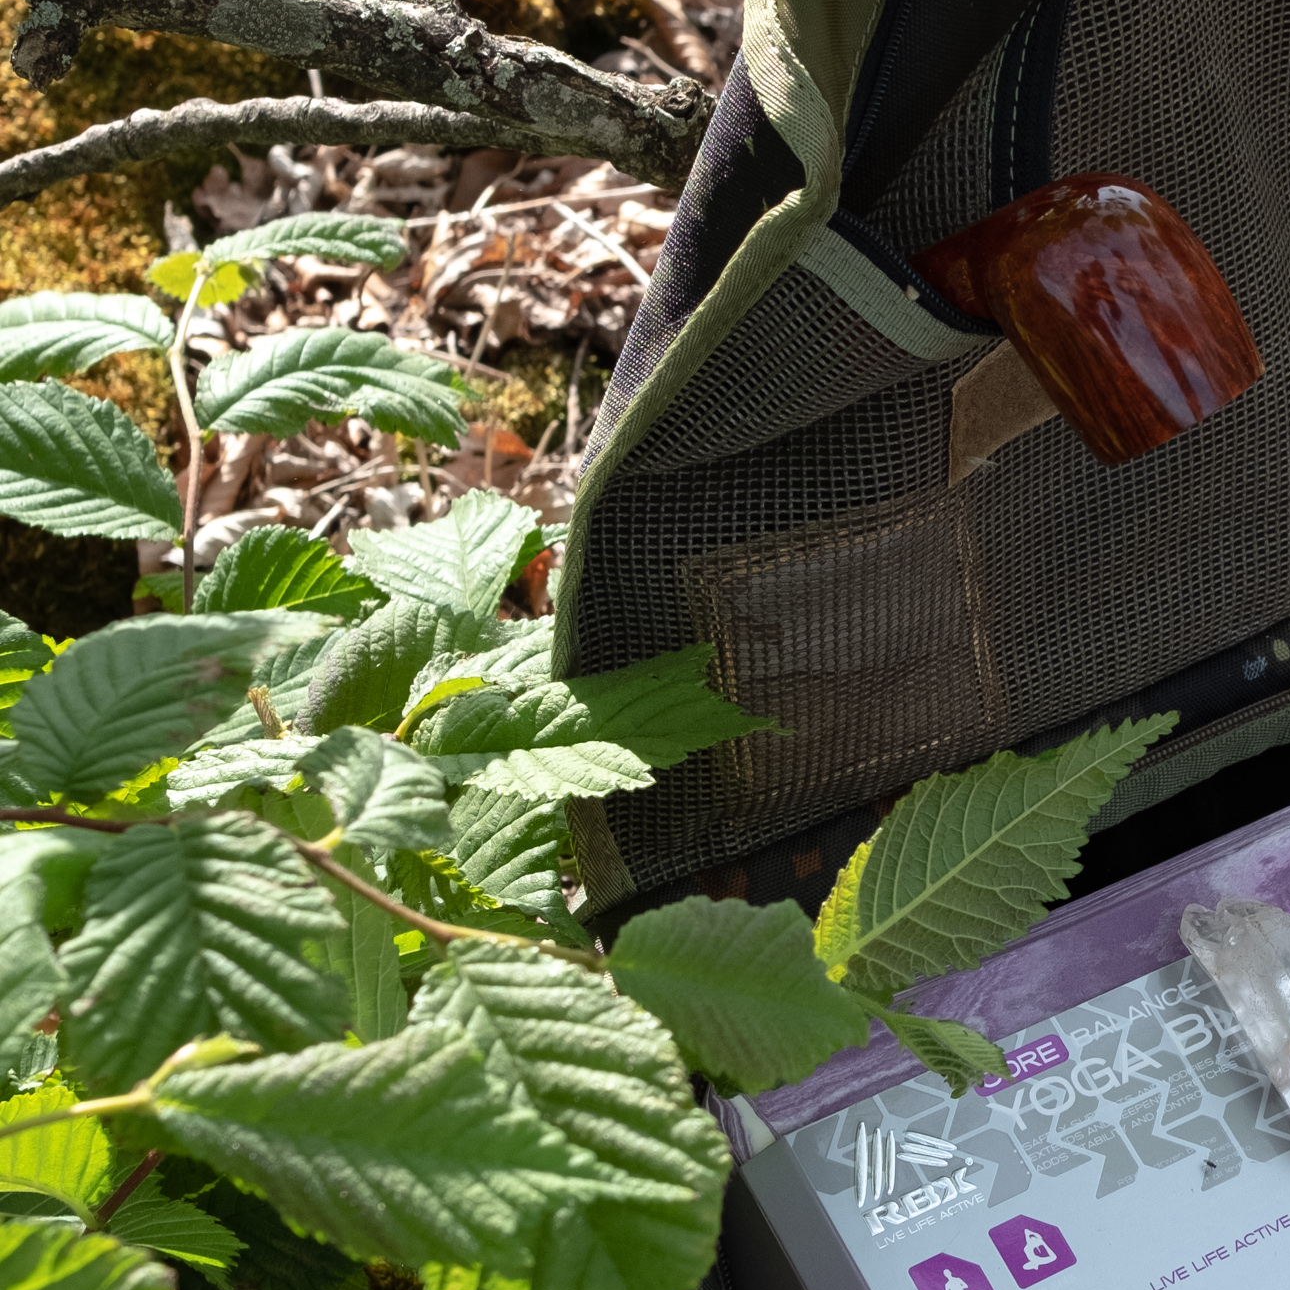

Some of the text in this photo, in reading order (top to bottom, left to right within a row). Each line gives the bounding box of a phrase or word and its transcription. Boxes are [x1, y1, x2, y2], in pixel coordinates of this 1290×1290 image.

[1070, 979, 1200, 1047] BALANCE
[987, 1046, 1162, 1129] YOGA
[1028, 1130, 1084, 1162] EXTEDS
[1035, 1151, 1068, 1172] ADDS
[1129, 1112, 1154, 1128] AND
[1158, 1089, 1204, 1115] ONTRO
[862, 1166, 977, 1236] RBX
[875, 1192, 985, 1249] LIVE LIFE ACTIVE
[1191, 1245, 1230, 1272] LIFE
